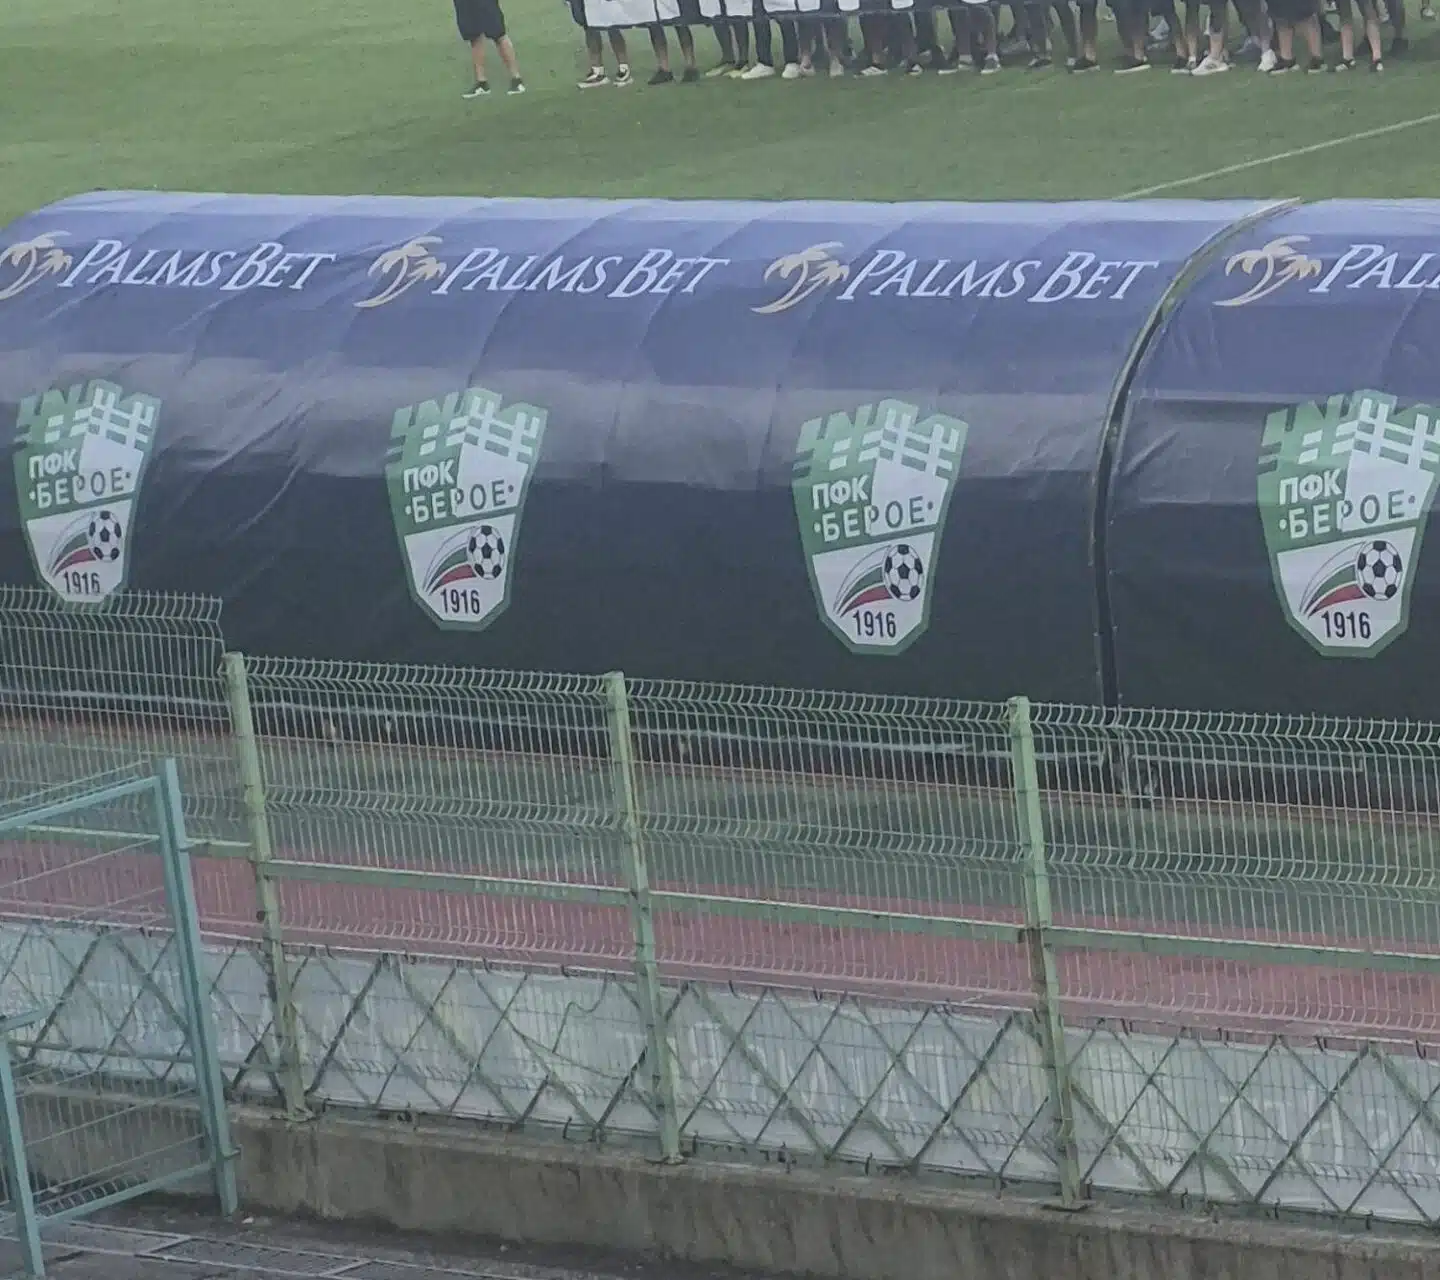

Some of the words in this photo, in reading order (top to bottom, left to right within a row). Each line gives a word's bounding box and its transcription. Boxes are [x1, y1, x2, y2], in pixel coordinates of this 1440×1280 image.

[57, 240, 239, 288] PALMS
[220, 242, 336, 291] BET
[432, 247, 623, 295] PALMS
[608, 248, 731, 298] BET
[836, 249, 1042, 301] PALMS
[1027, 251, 1159, 303] BET
[29, 447, 77, 480] ПФК
[403, 458, 455, 494] ПФК
[812, 474, 870, 510] ПФК
[1279, 468, 1344, 506] ПФК
[63, 570, 100, 595] 1916
[440, 588, 480, 615] 1916
[852, 610, 896, 638] 1916
[1321, 610, 1372, 639] 1916
